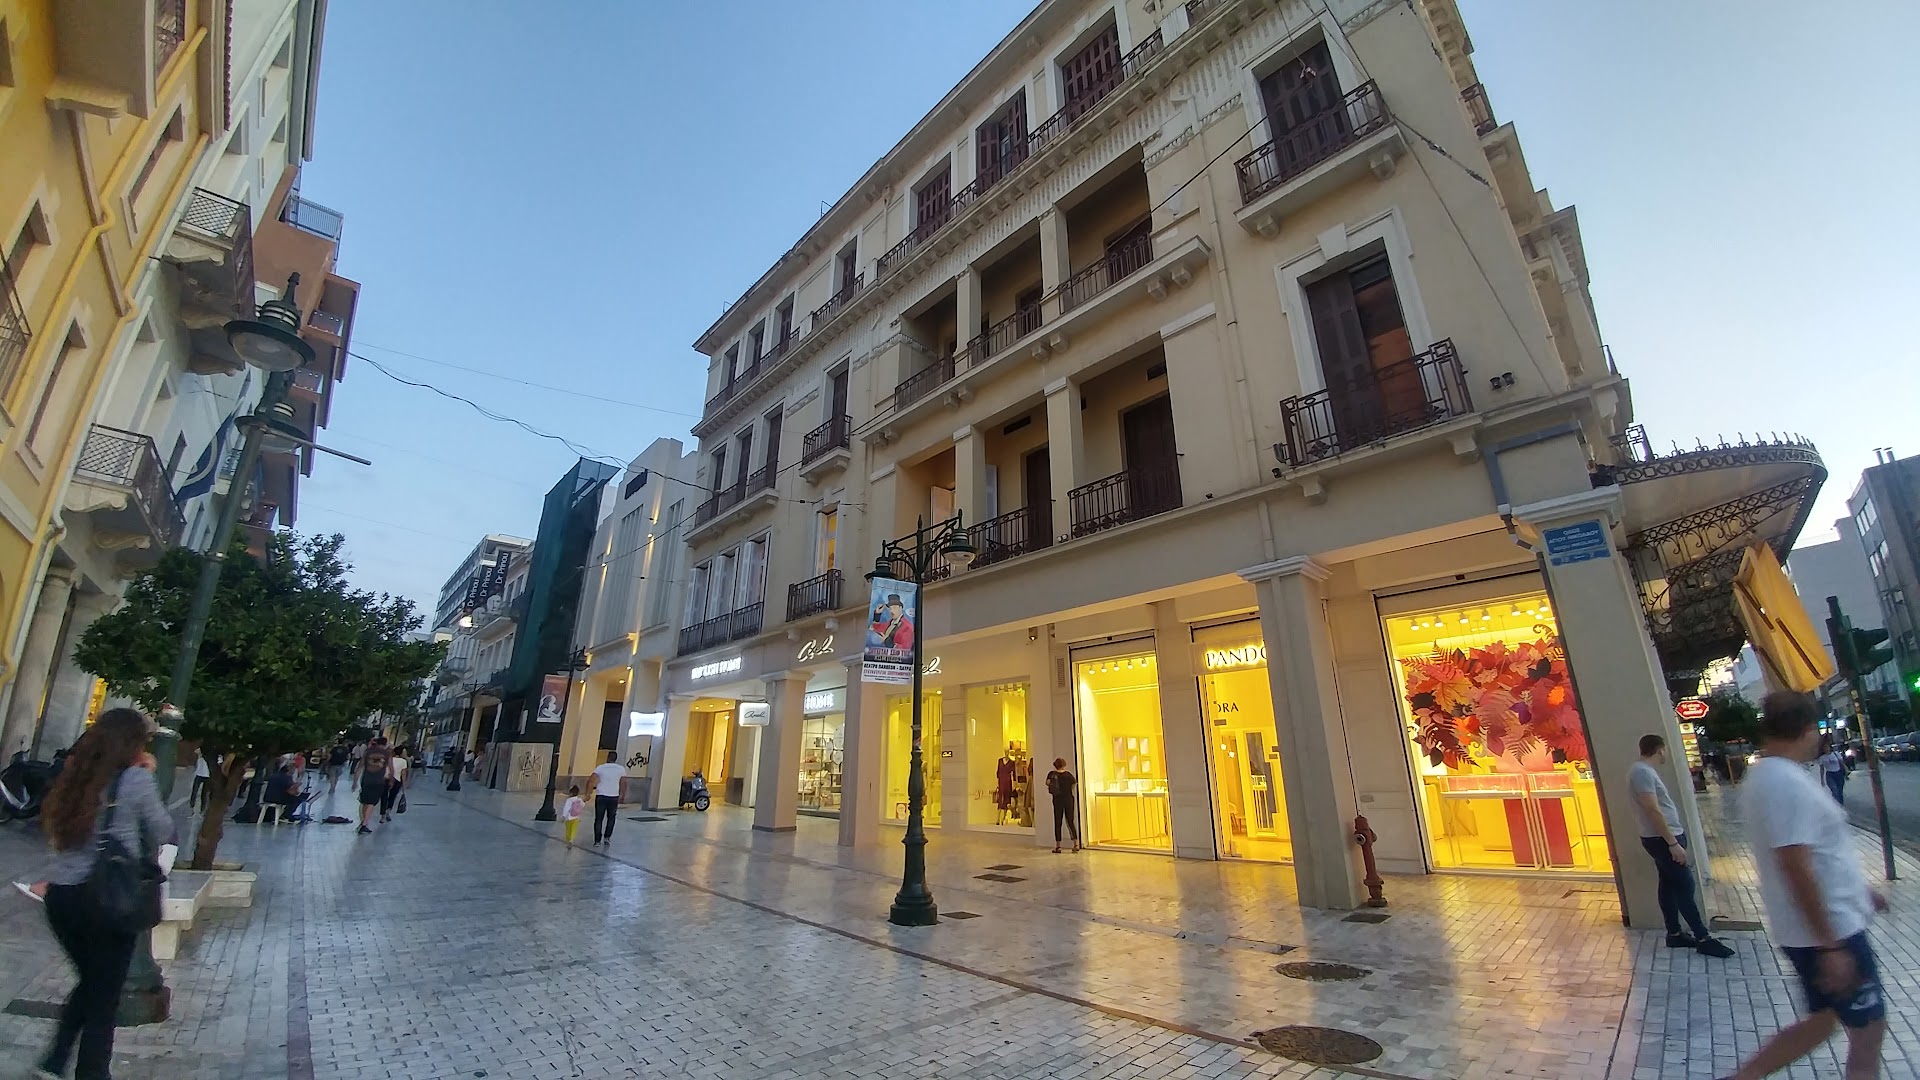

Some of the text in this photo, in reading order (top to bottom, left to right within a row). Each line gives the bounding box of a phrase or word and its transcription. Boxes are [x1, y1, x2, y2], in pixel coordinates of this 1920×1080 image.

[480, 567, 493, 597] Dr Prinou
[495, 552, 509, 584] Dr Prinou
[467, 579, 480, 607] Dr Prinou
